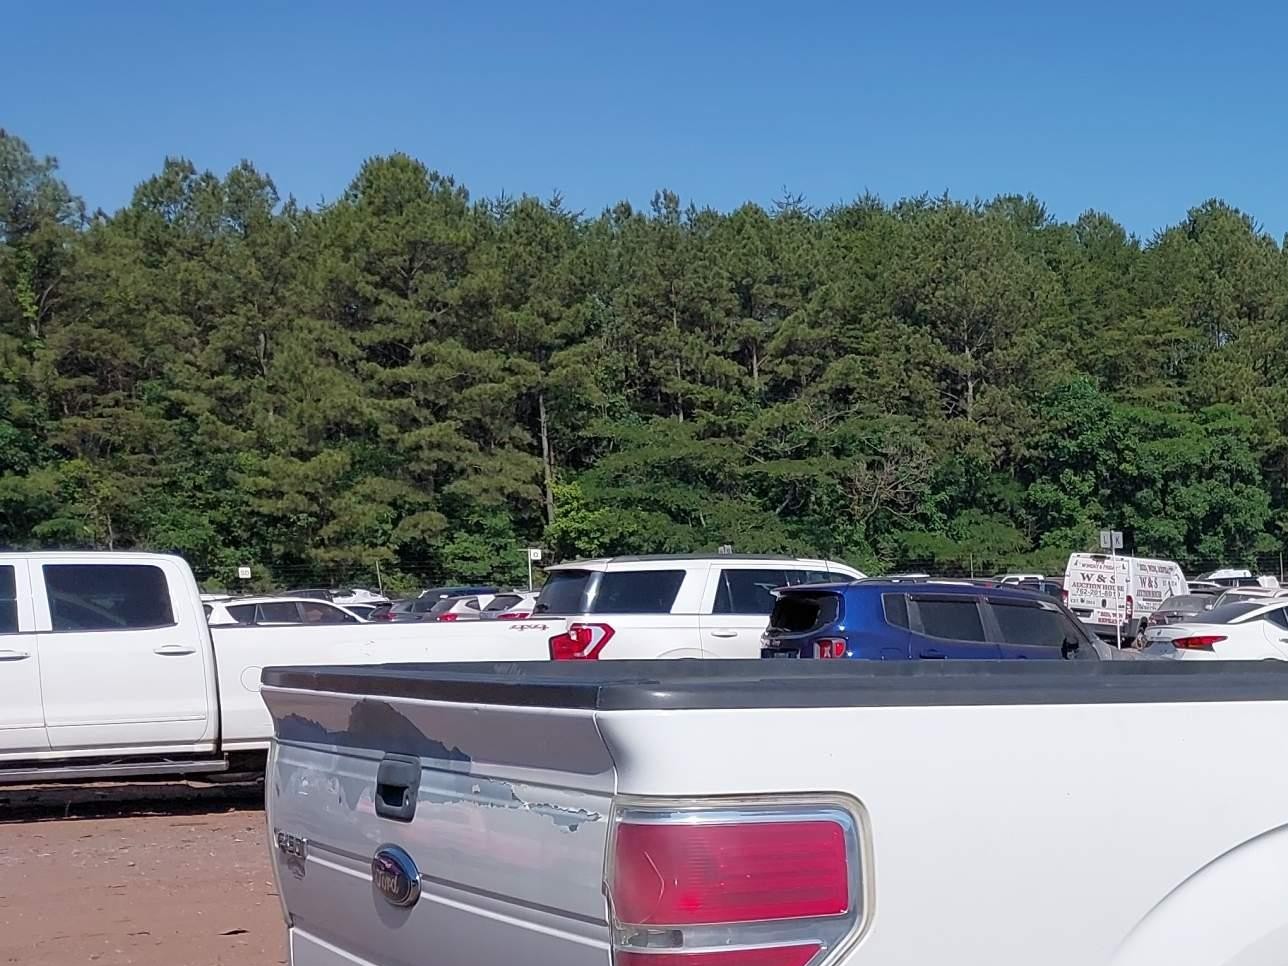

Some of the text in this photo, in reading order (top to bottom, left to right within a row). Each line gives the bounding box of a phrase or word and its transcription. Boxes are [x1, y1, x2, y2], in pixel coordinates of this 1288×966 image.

[1080, 572, 1095, 582] W
[1096, 574, 1107, 583] &
[1139, 576, 1147, 588] W
[1148, 576, 1153, 588] &
[1154, 576, 1158, 588] S
